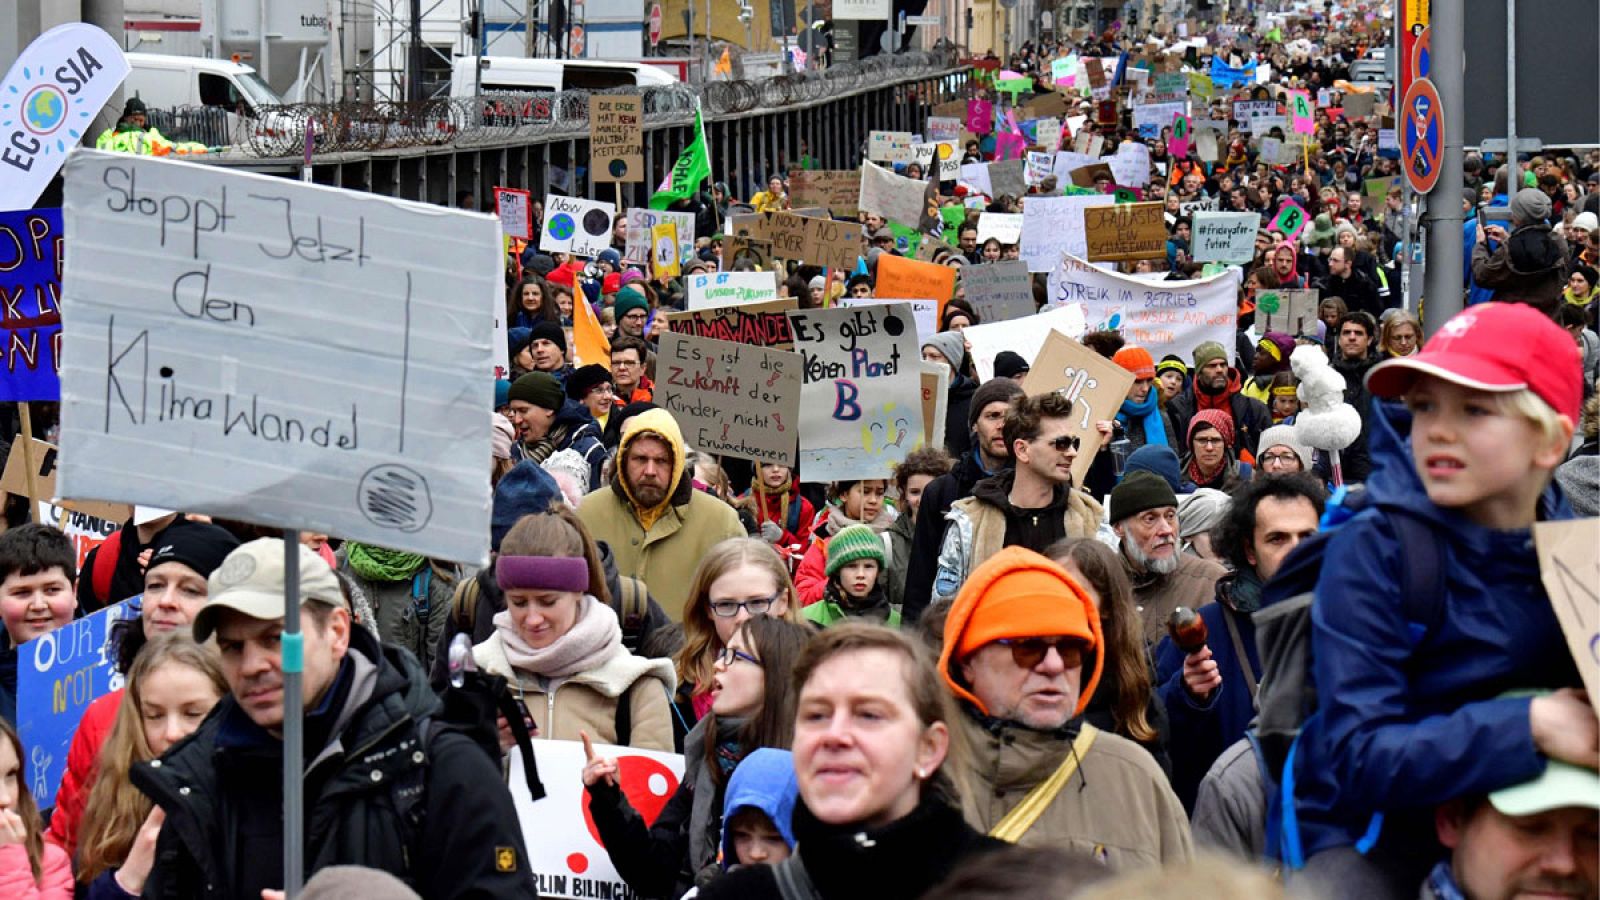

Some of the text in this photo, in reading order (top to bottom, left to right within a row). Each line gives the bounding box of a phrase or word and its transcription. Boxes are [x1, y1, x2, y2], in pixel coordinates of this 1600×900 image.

[598, 113, 616, 123] HAT
[1297, 97, 1308, 116] A
[1174, 120, 1183, 137] A
[915, 147, 933, 158] YOU
[673, 150, 694, 193] KOHLE
[102, 166, 371, 268] Stoppt Jetzt
[550, 197, 582, 213] Now
[1284, 209, 1300, 228] B
[769, 231, 803, 253] NEVER
[816, 222, 838, 242] NO
[813, 242, 856, 269] TIME
[172, 264, 255, 327] den
[1057, 281, 1197, 308] STREIK IM BETRIEB
[794, 311, 878, 352] Es gibt
[676, 340, 784, 372] Es ist die
[852, 343, 901, 378] Planet
[667, 366, 782, 404] Zukunft der
[832, 378, 863, 422] B
[733, 411, 769, 428] nicht
[697, 428, 788, 463] Erwachsenen
[34, 619, 93, 673] OUR
[52, 663, 97, 715] NOT
